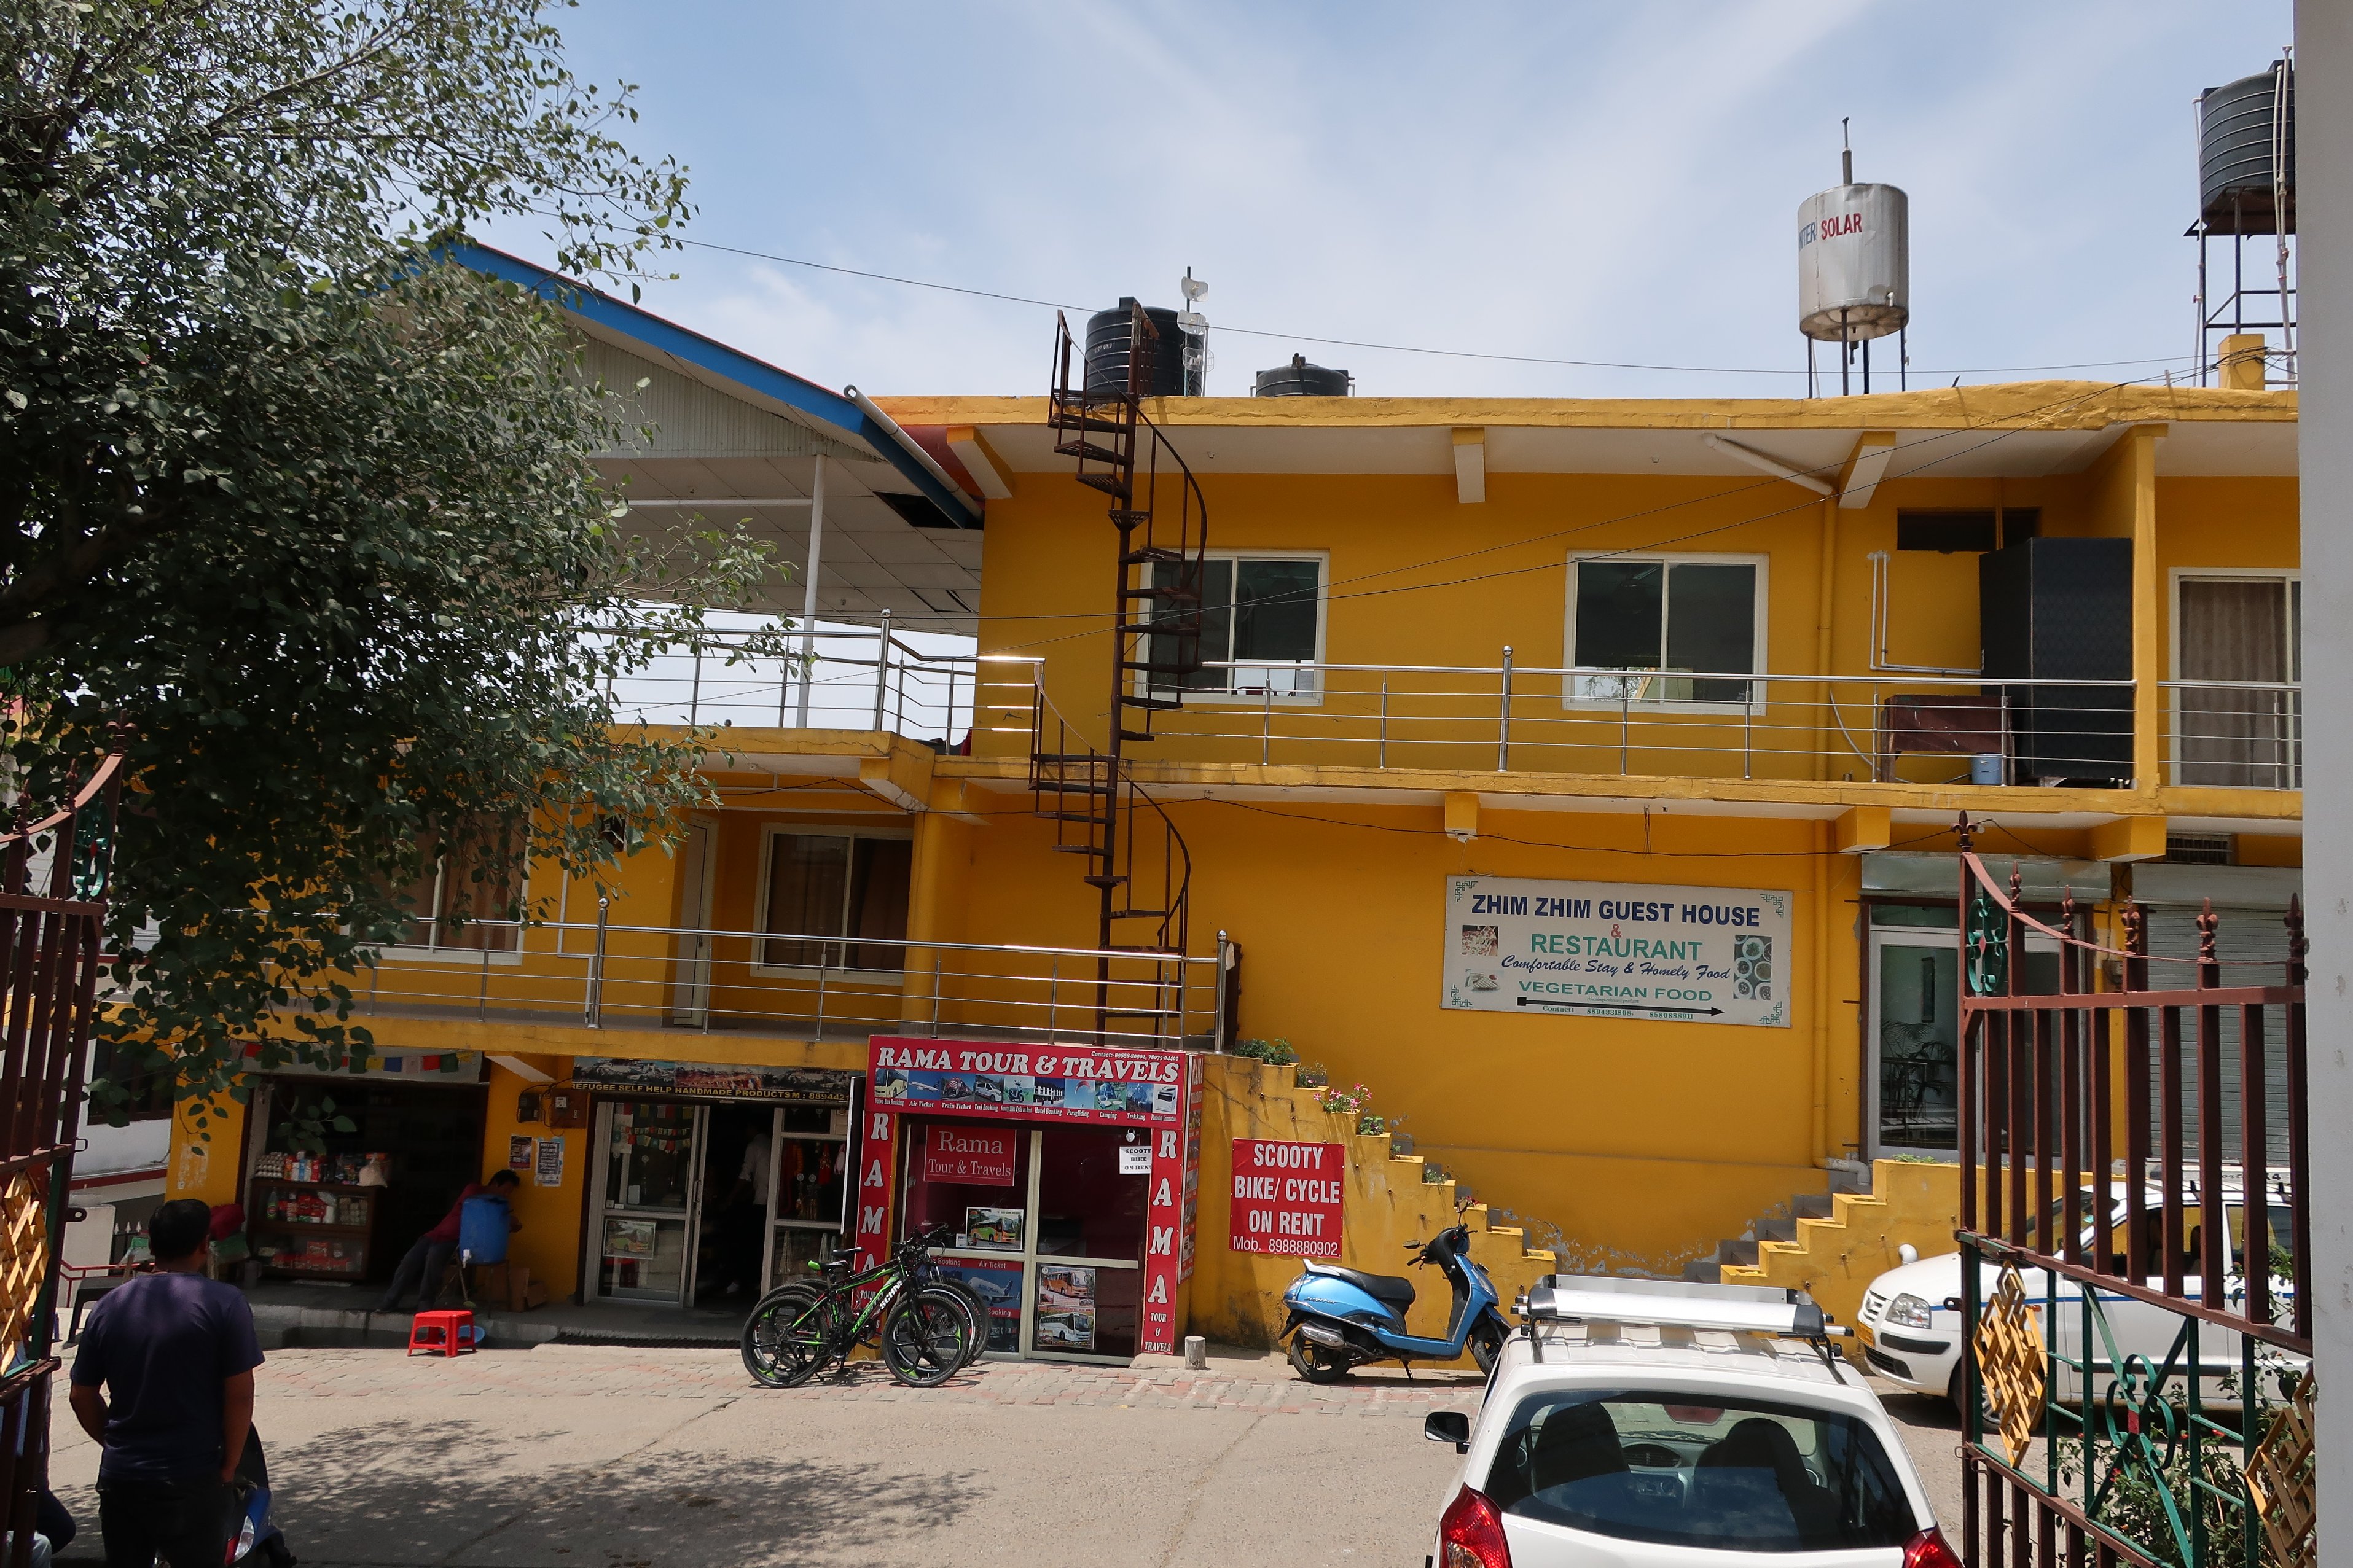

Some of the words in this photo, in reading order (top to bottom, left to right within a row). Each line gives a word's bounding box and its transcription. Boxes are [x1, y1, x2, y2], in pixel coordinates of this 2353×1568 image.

[1821, 213, 1862, 240] SOLAR
[1471, 895, 1527, 915] ZHIM
[1535, 897, 1591, 919] ZHIM
[1599, 900, 1674, 922] GUEST
[1682, 904, 1760, 927] HOUSE
[1610, 923, 1622, 938] &
[1532, 934, 1703, 961] RESTAURANT
[1501, 954, 1580, 973] Comfortable
[1584, 959, 1619, 977] Stay
[1623, 962, 1634, 974] &
[1640, 962, 1690, 980] Homely
[1695, 965, 1731, 980] Food
[1519, 981, 1648, 999] VEGETARIAN
[1654, 988, 1712, 1002] FOOD
[877, 1047, 952, 1070] RAMA
[960, 1051, 1029, 1074] TOUR
[1035, 1055, 1057, 1075] &
[1062, 1056, 1180, 1082] TRAVELS
[675, 1087, 732, 1096] HANDMADE
[983, 1104, 998, 1112] Booking
[1046, 1107, 1062, 1116] Booking
[1067, 1109, 1089, 1118] Paragliding
[1099, 1111, 1117, 1120] Camping
[1127, 1112, 1146, 1121] Trekking
[938, 1131, 1003, 1155] Rama
[1253, 1144, 1324, 1169] SCOOTY
[928, 1158, 953, 1174] Tour
[957, 1160, 966, 1174] &
[970, 1161, 1011, 1177] Travels
[1235, 1176, 1281, 1203] BIKE/
[1285, 1178, 1341, 1204] CYCLE
[1248, 1209, 1273, 1233] ON
[1278, 1211, 1325, 1236] RENT
[1234, 1236, 1261, 1252] Mob.
[1268, 1238, 1338, 1256] 8988880902
[987, 1308, 1011, 1317] Booking
[1150, 1313, 1167, 1322] TOUR
[1145, 1341, 1171, 1352] TRAVELS
